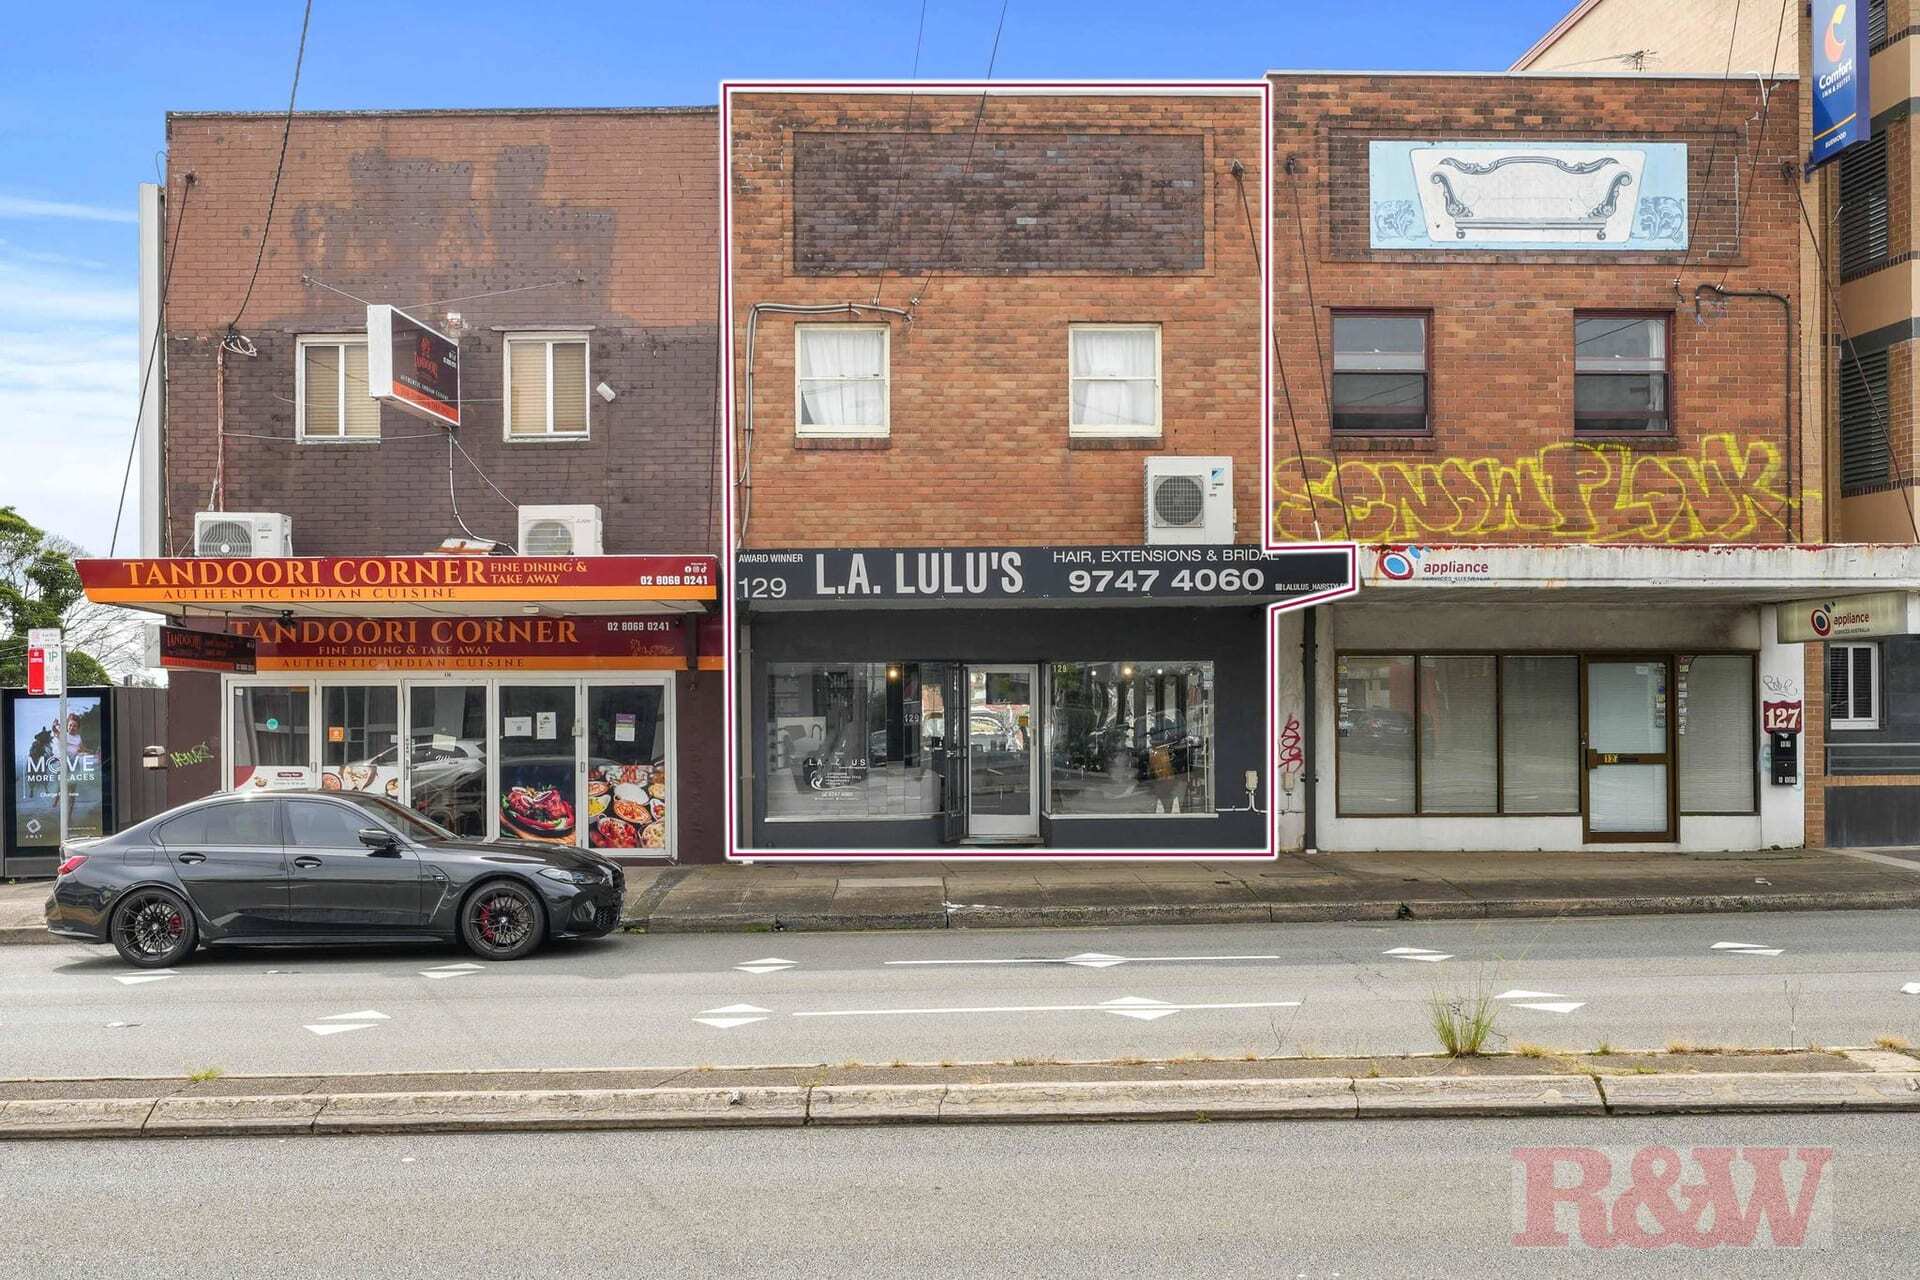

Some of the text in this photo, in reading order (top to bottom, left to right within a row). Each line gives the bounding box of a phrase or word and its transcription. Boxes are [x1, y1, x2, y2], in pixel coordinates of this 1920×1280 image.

[1819, 59, 1852, 89] Comfort
[738, 553, 804, 563] AWARD WINNER
[1053, 548, 1280, 564] HAIR, EXTENSIONS & BRIDAL
[123, 559, 487, 586] TANDOORI CORNER
[490, 561, 588, 573] FINE DINING &
[815, 551, 1024, 595] L.A. LULU'S
[1424, 560, 1489, 575] appliance
[490, 573, 560, 585] TAKE AWAY
[640, 576, 653, 585] 02
[684, 575, 708, 585] 0241
[1069, 568, 1265, 593] 9747 4060
[163, 587, 456, 600] AUTHENTIC INDIAN CUISINE
[738, 577, 787, 599] 129
[607, 622, 619, 631] 02
[647, 622, 669, 631] 0241
[1833, 612, 1870, 627] appliance
[230, 620, 578, 644] TANDOORI CORNER
[319, 645, 490, 655] FINE DINING & TAKE AWAY
[282, 658, 525, 668] AUTHENTIC INDIAN CUISINE
[1765, 707, 1801, 729] 127
[27, 754, 95, 774] MOVE
[27, 773, 95, 782] MORE ACES
